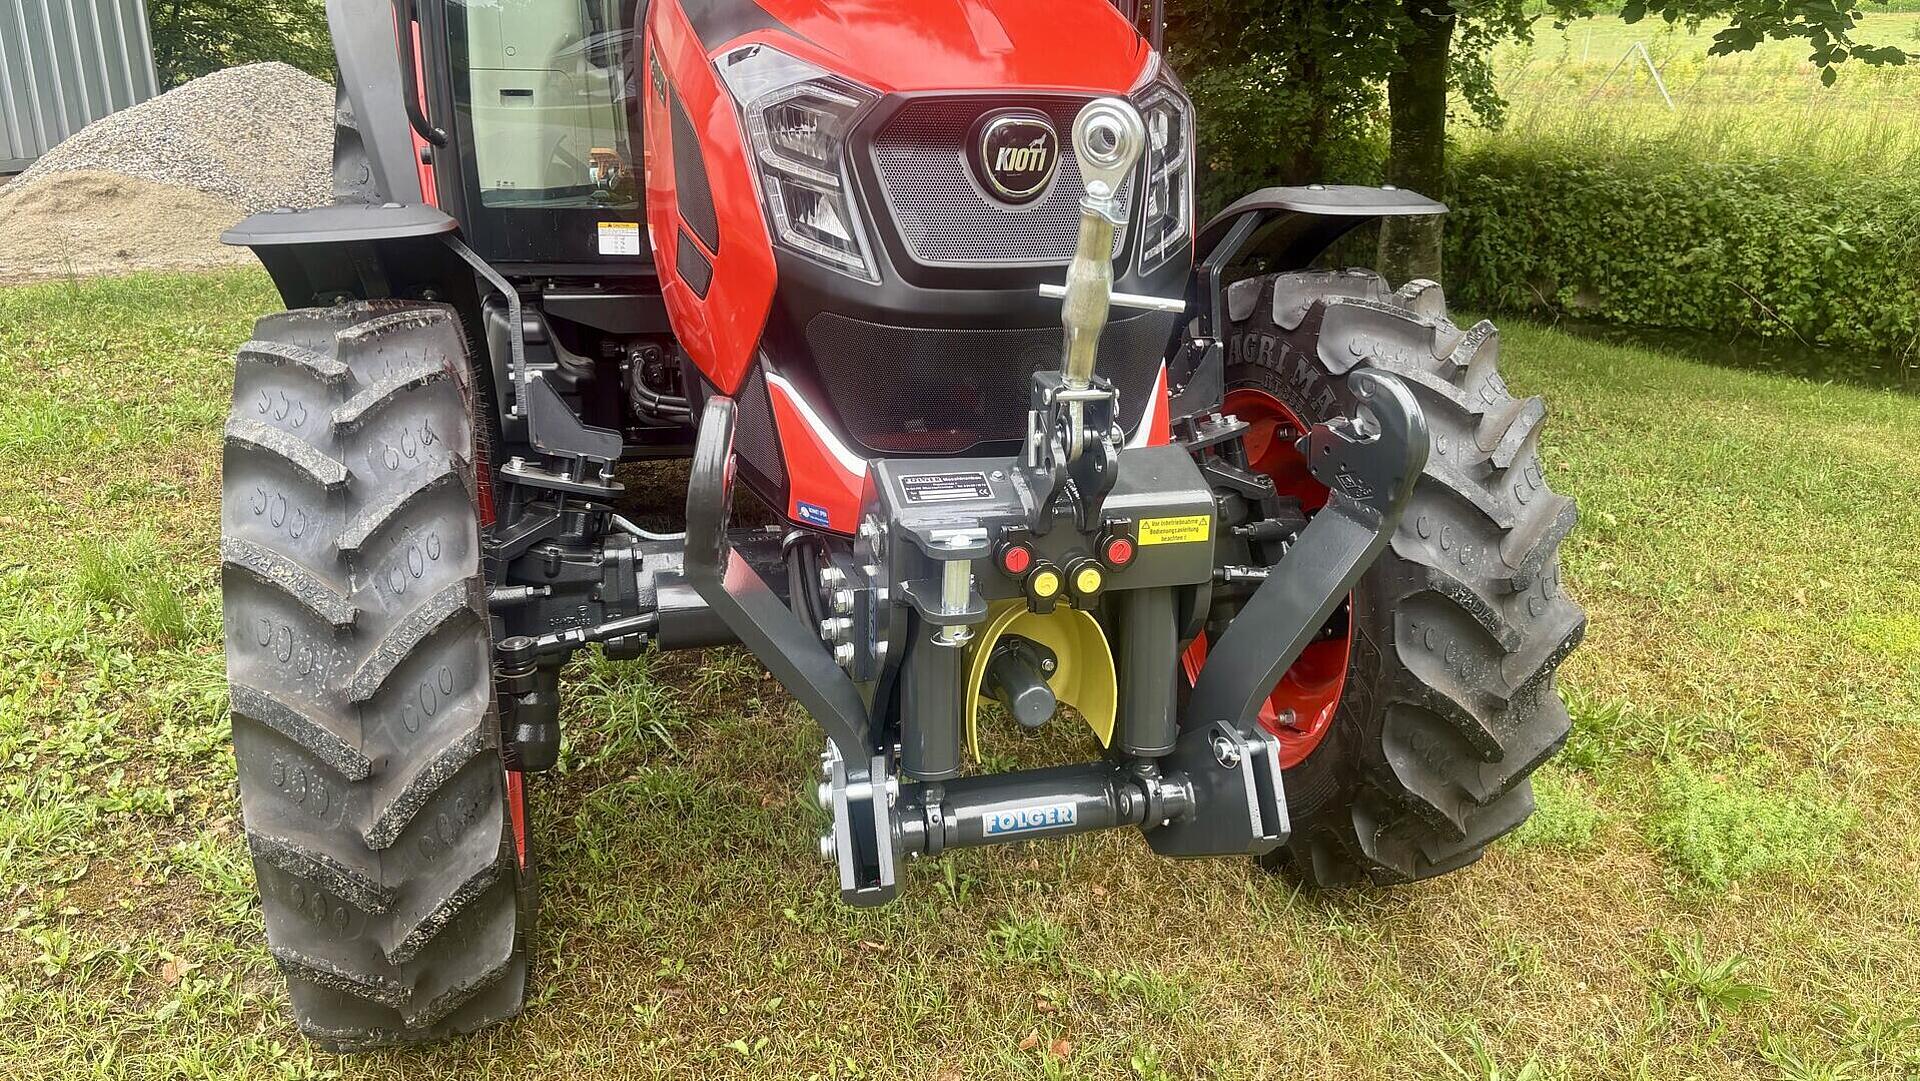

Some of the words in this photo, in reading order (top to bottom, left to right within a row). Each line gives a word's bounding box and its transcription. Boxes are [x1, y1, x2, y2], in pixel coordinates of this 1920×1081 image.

[995, 147, 1047, 171] KIOTI
[1115, 543, 1126, 562] 2
[986, 806, 1073, 832] FOLGER
